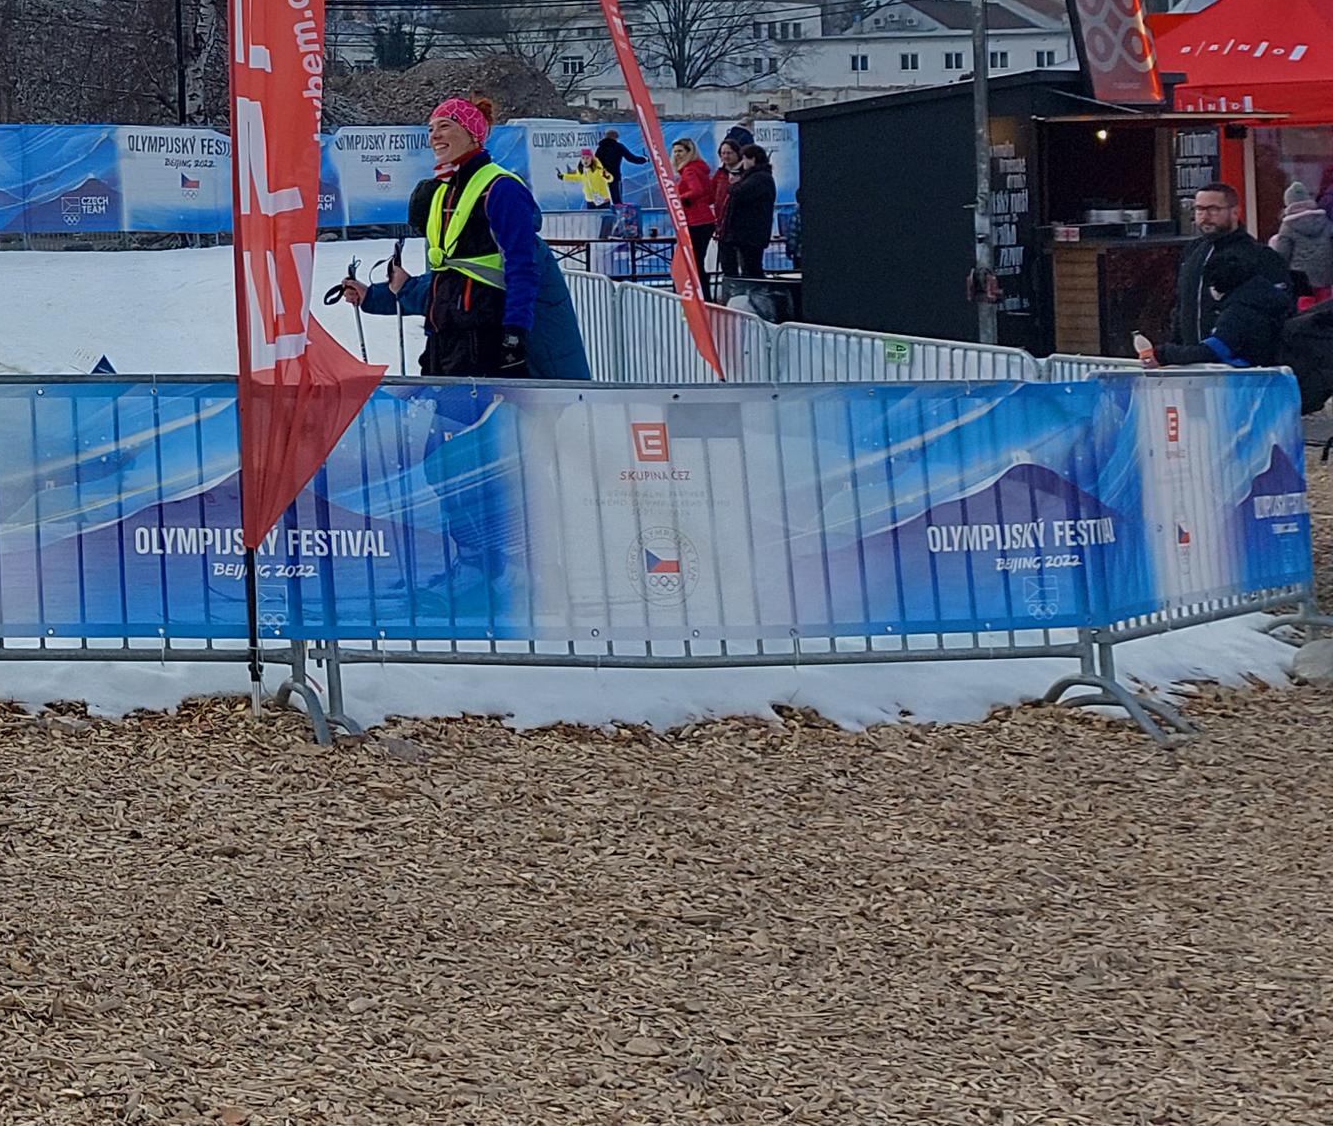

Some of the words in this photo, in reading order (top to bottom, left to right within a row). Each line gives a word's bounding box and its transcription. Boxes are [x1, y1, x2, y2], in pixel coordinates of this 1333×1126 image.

[128, 134, 196, 155] OLYMPIJSKÝ
[80, 195, 109, 207] CZECH
[81, 205, 106, 216] TEAM
[619, 471, 669, 482] SKUPINA
[671, 468, 691, 481] ČEZ
[288, 529, 390, 557] FESTIVAL
[926, 518, 1046, 553] OLYMPIJSKÝ
[275, 564, 319, 578] 2022
[996, 556, 1041, 574] BEIJING
[1045, 554, 1082, 569] 2022
